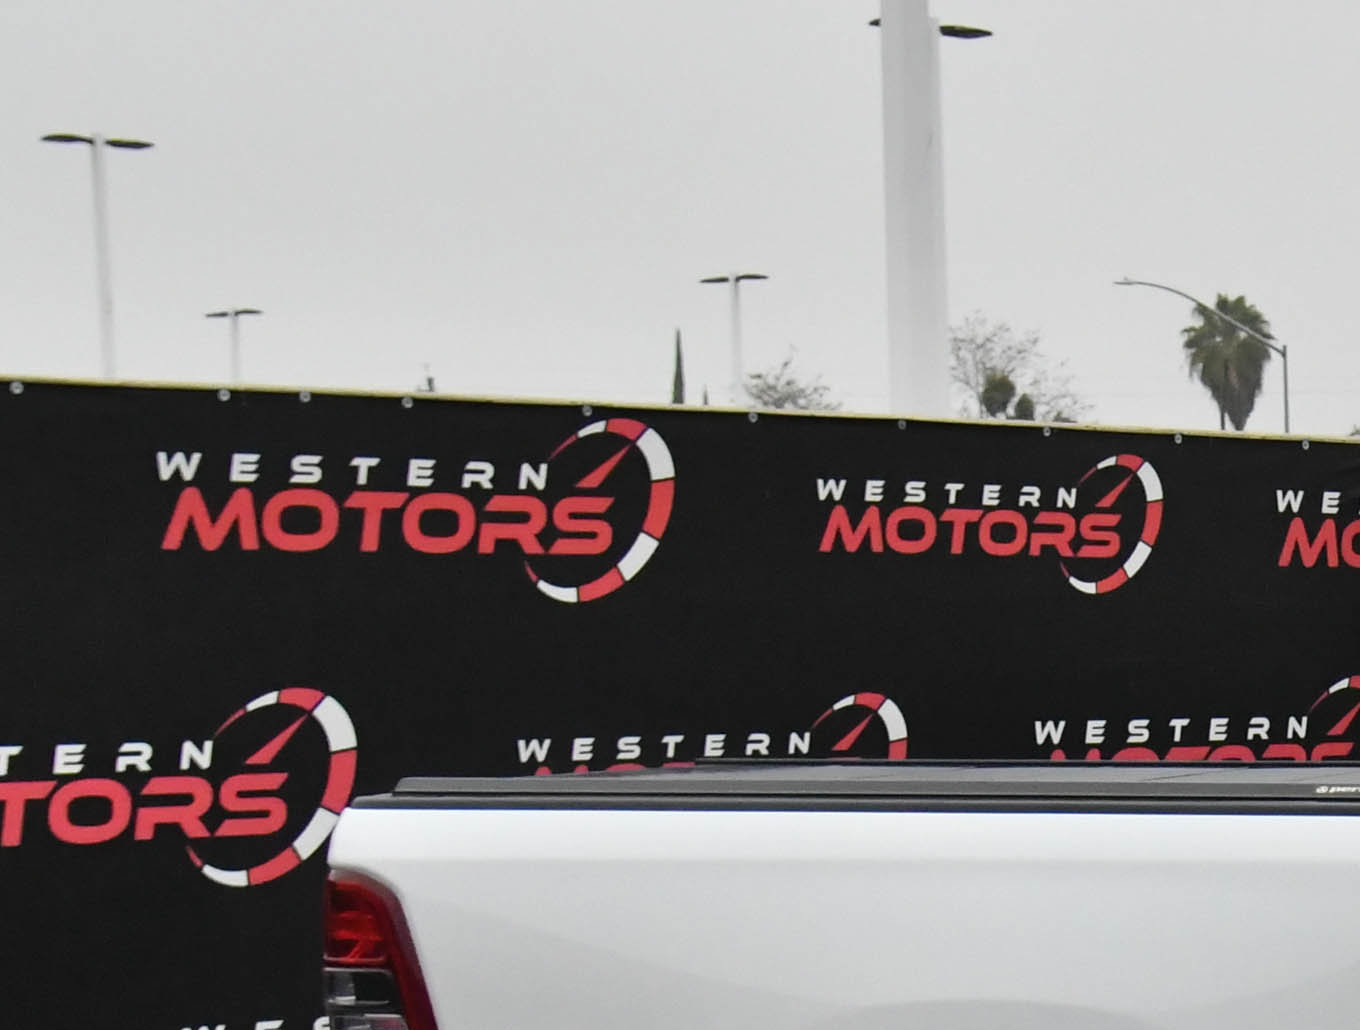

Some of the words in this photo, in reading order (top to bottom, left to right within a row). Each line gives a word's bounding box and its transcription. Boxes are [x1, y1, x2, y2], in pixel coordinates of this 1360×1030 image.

[156, 451, 548, 491] WESTERN
[816, 478, 1077, 509] WESTERN
[161, 486, 615, 556] MOTORS
[818, 505, 1121, 559] MOTORS
[517, 731, 812, 763] WESTERN
[1034, 715, 1308, 745] WESTERN
[0, 772, 289, 847] TORS
